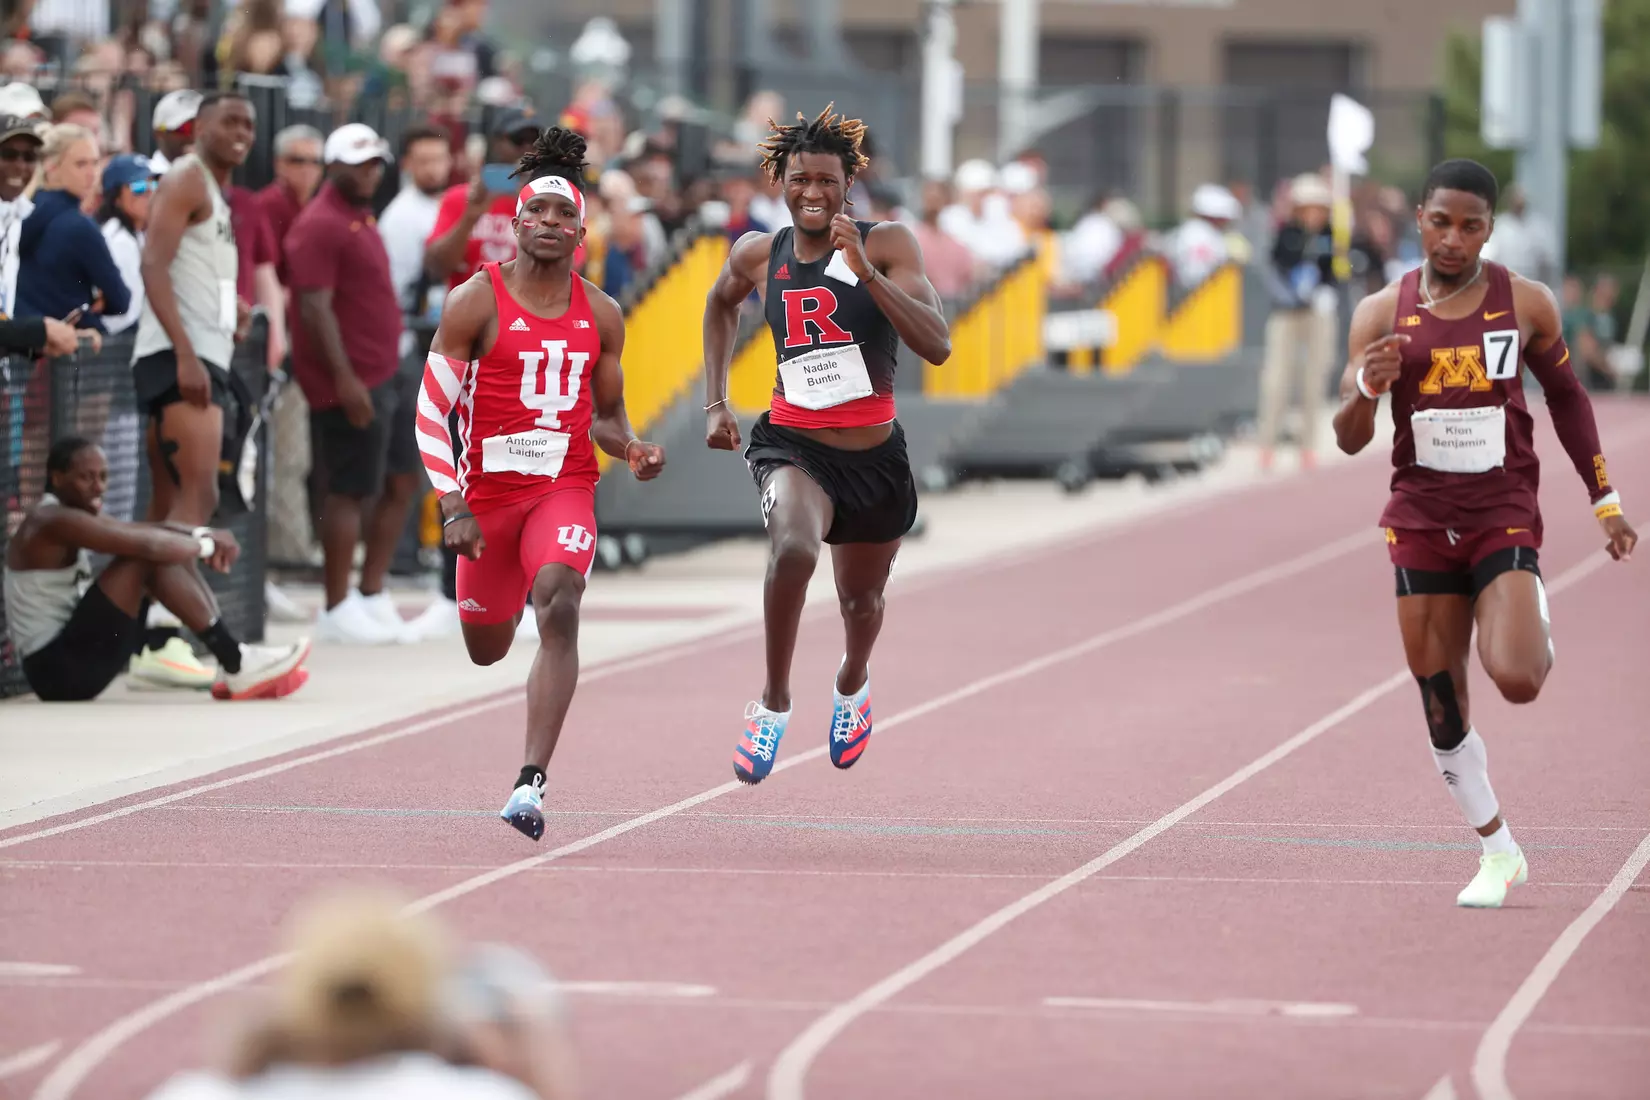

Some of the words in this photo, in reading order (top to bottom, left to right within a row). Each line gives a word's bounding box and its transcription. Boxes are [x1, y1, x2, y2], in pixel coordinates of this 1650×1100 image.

[781, 286, 854, 348] R
[1489, 335, 1514, 375] 7
[803, 360, 838, 375] Nadale
[1419, 344, 1494, 395] M
[806, 372, 841, 387] Buntin
[1445, 424, 1473, 435] Kion
[505, 436, 548, 447] Antonio
[1432, 437, 1487, 449] Benjamin
[508, 446, 546, 459] Laidler
